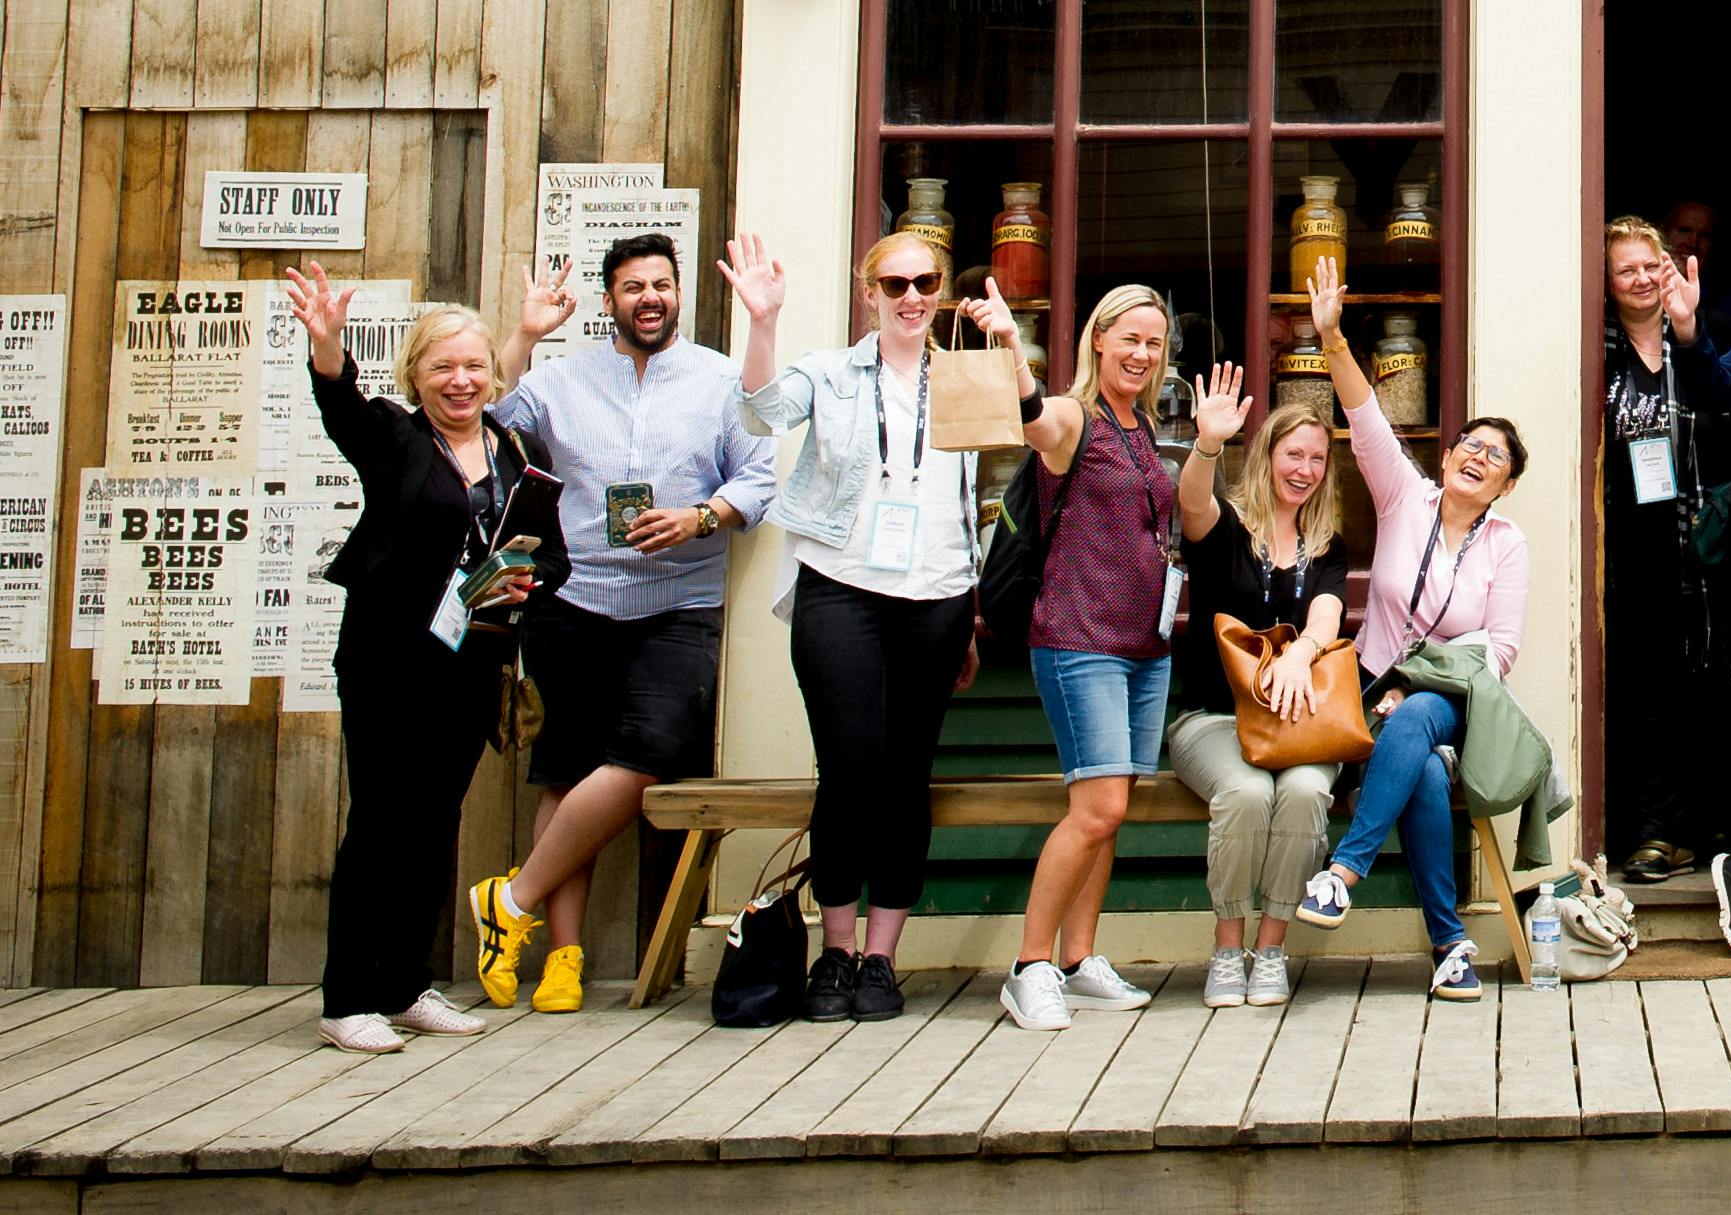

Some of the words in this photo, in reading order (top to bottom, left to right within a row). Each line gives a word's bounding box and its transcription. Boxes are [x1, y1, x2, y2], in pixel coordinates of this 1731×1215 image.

[547, 175, 656, 189] WASHINGTON
[220, 187, 279, 215] STAFF
[292, 188, 341, 216] ONLY
[651, 202, 662, 213] THE
[218, 221, 232, 233] Not
[235, 222, 254, 235] Open
[258, 222, 271, 234] For
[273, 222, 297, 234] Public
[300, 222, 340, 236] Inspection
[137, 292, 243, 314] EAGLE
[11, 311, 55, 331] OFF!!
[127, 320, 187, 350] DINING
[198, 319, 251, 348] ROOMS
[4, 337, 33, 350] OFF!!
[132, 353, 202, 363] BALLARAT
[208, 352, 241, 361] FLAT
[1, 406, 34, 419] HATS,
[127, 413, 160, 424] Breakfast
[179, 412, 202, 423] Dinner
[219, 411, 243, 424] Supper
[4, 421, 50, 435] CALICOS
[132, 437, 200, 445] SOUPS
[131, 451, 152, 463] TEA
[160, 451, 168, 462] &
[176, 449, 214, 462] COFFEE
[315, 475, 350, 486] BEDS
[10, 518, 46, 533] CIRCUS
[121, 508, 249, 541] BEES
[141, 545, 223, 568] BEES
[147, 572, 215, 590] BEES
[80, 595, 91, 606] OF
[127, 596, 193, 606] ALEXANDER
[198, 596, 233, 606] KELLY
[305, 595, 336, 605] Races!
[143, 609, 163, 617] has
[169, 609, 215, 617] received
[192, 619, 203, 627] to
[208, 619, 234, 627] offer
[149, 629, 166, 637] for
[171, 629, 191, 637] sale
[197, 629, 206, 637] at
[131, 640, 176, 655] BATH'S
[182, 640, 222, 655] HOTEL
[125, 678, 135, 690] 15
[140, 678, 172, 690] HIVES
[178, 678, 190, 689] OF
[195, 678, 223, 690] BEES.
